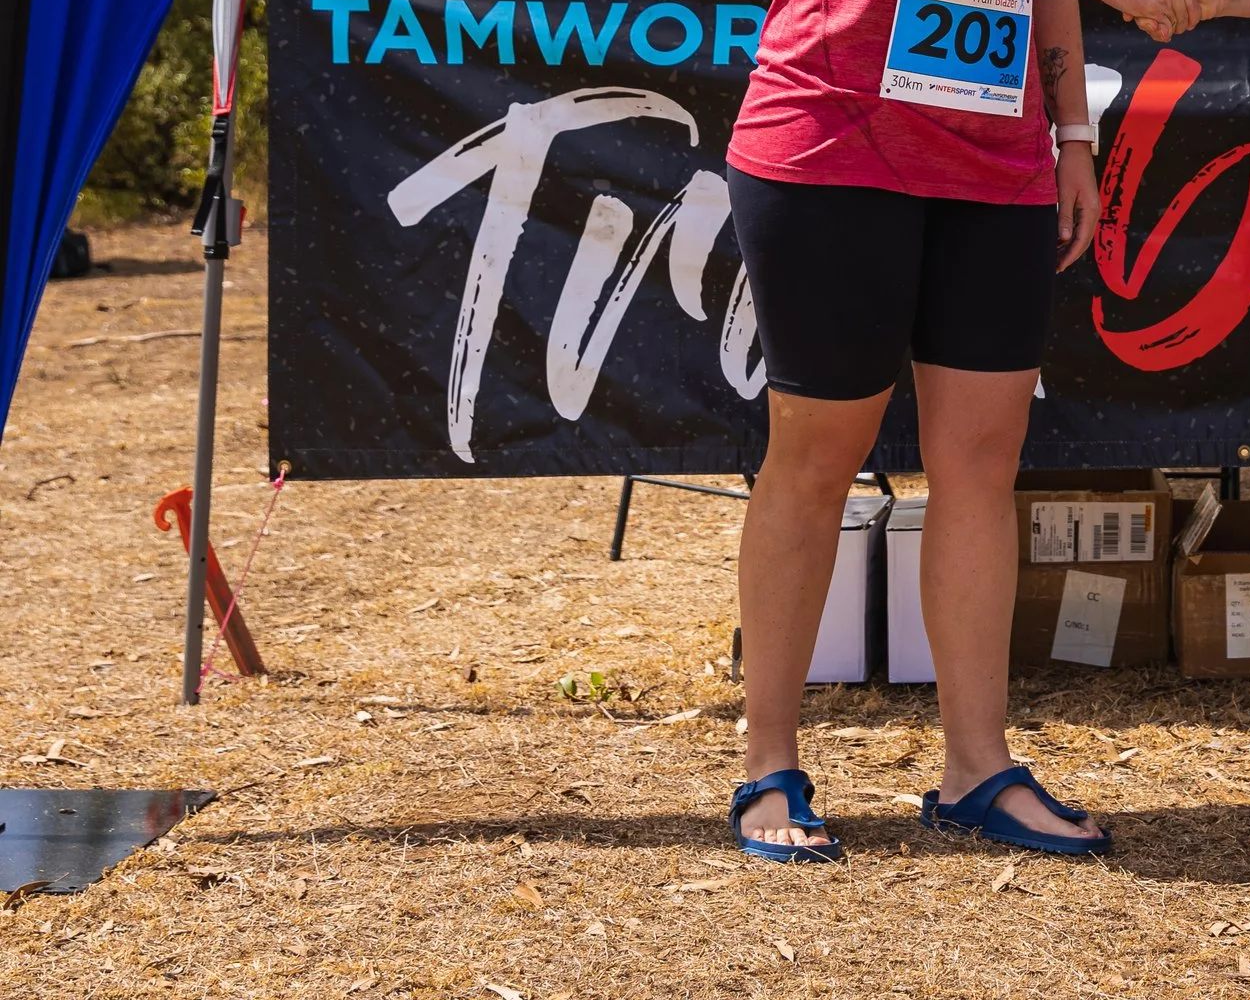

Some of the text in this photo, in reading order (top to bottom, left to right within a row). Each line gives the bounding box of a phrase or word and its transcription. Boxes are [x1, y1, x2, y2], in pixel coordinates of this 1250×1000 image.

[908, 3, 1017, 69] 203
[890, 74, 923, 92] 30km
[935, 84, 976, 97] INTERSPORT
[999, 72, 1019, 86] 2026
